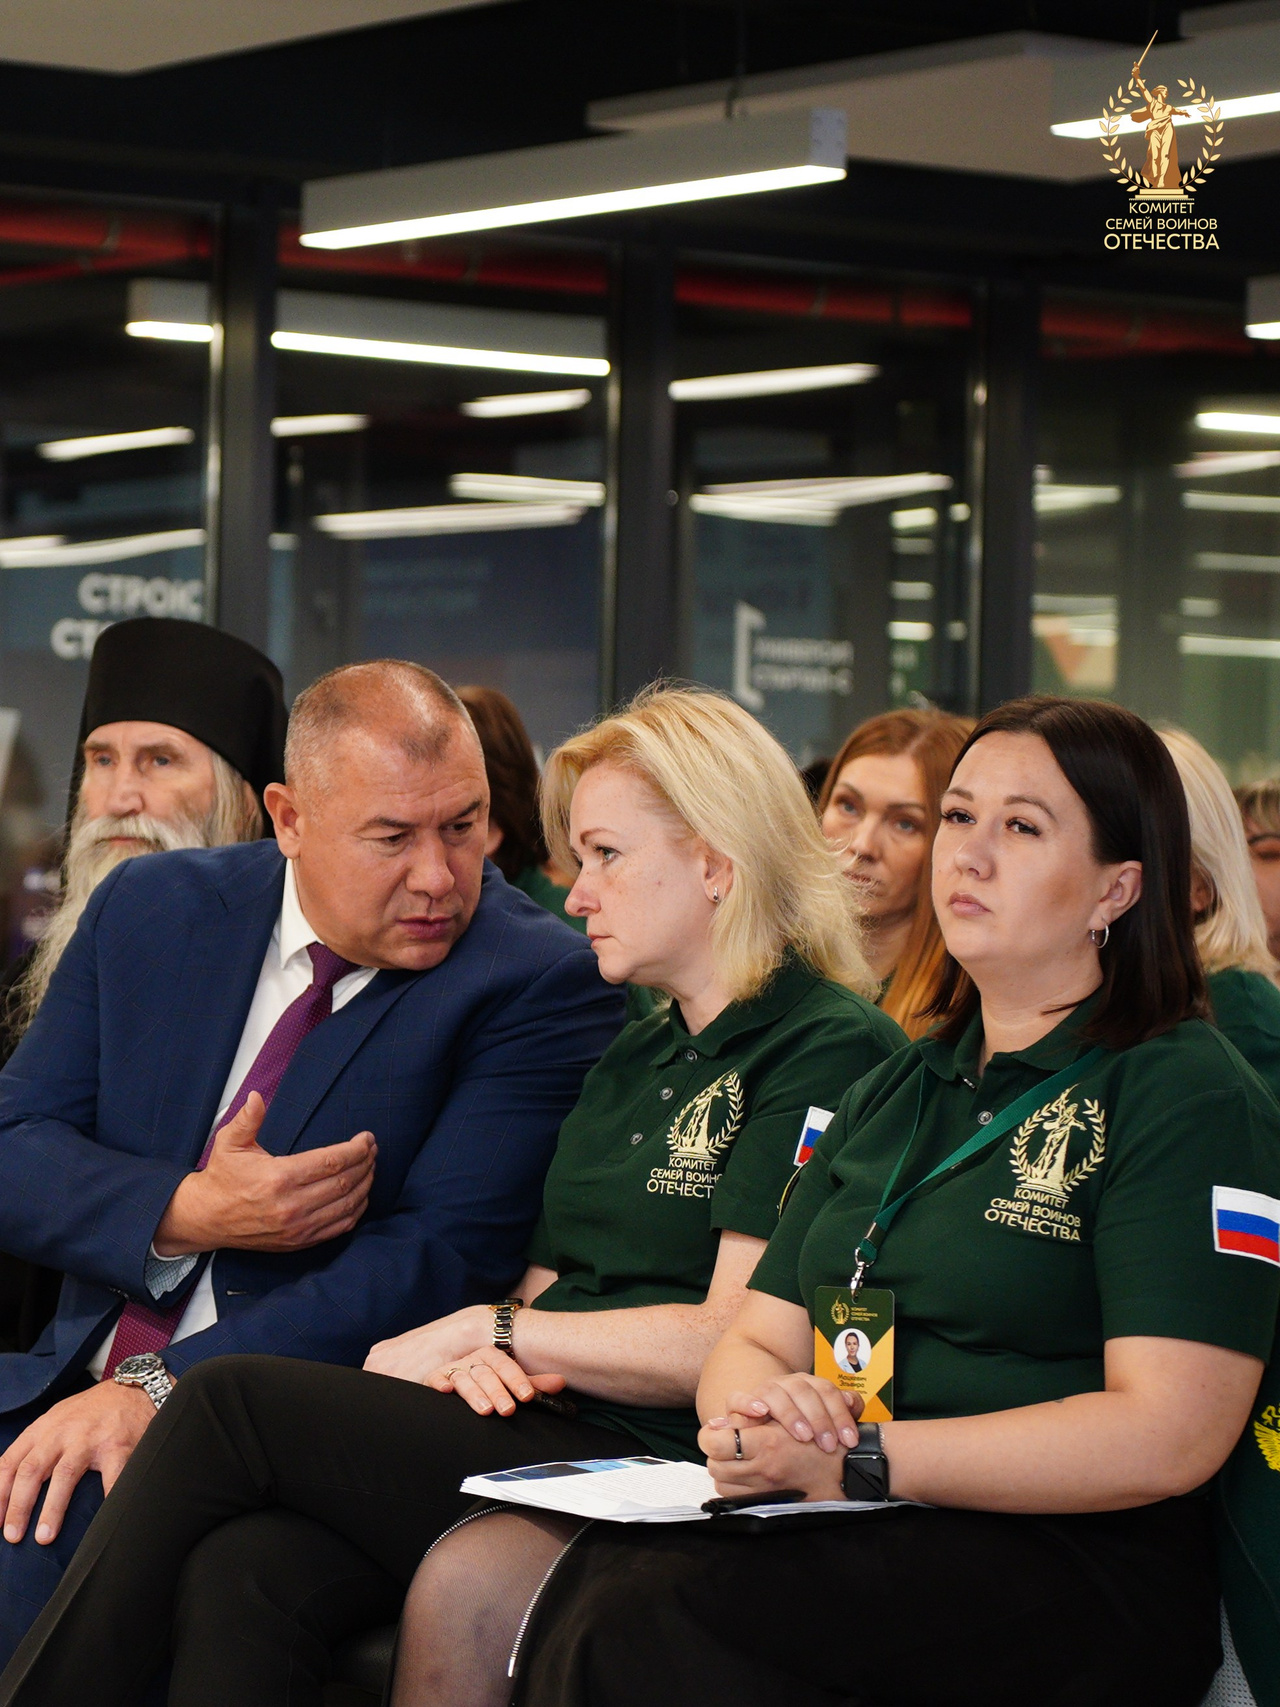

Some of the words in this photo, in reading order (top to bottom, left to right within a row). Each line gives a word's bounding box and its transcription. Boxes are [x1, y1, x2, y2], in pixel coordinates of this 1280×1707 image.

[668, 1157, 717, 1171] КОМИТЕТ
[650, 1167, 683, 1180] СЕМЕЙ
[686, 1171, 722, 1183] ВОИН
[647, 1178, 715, 1199] ОТЕЧЕСТ
[1014, 1188, 1069, 1209] КОМИТЕТ
[990, 1198, 1030, 1213] СЕМЕЙ
[1032, 1205, 1081, 1227] ВОИНОВ
[984, 1208, 1081, 1241] ОТЕЧЕСТВА
